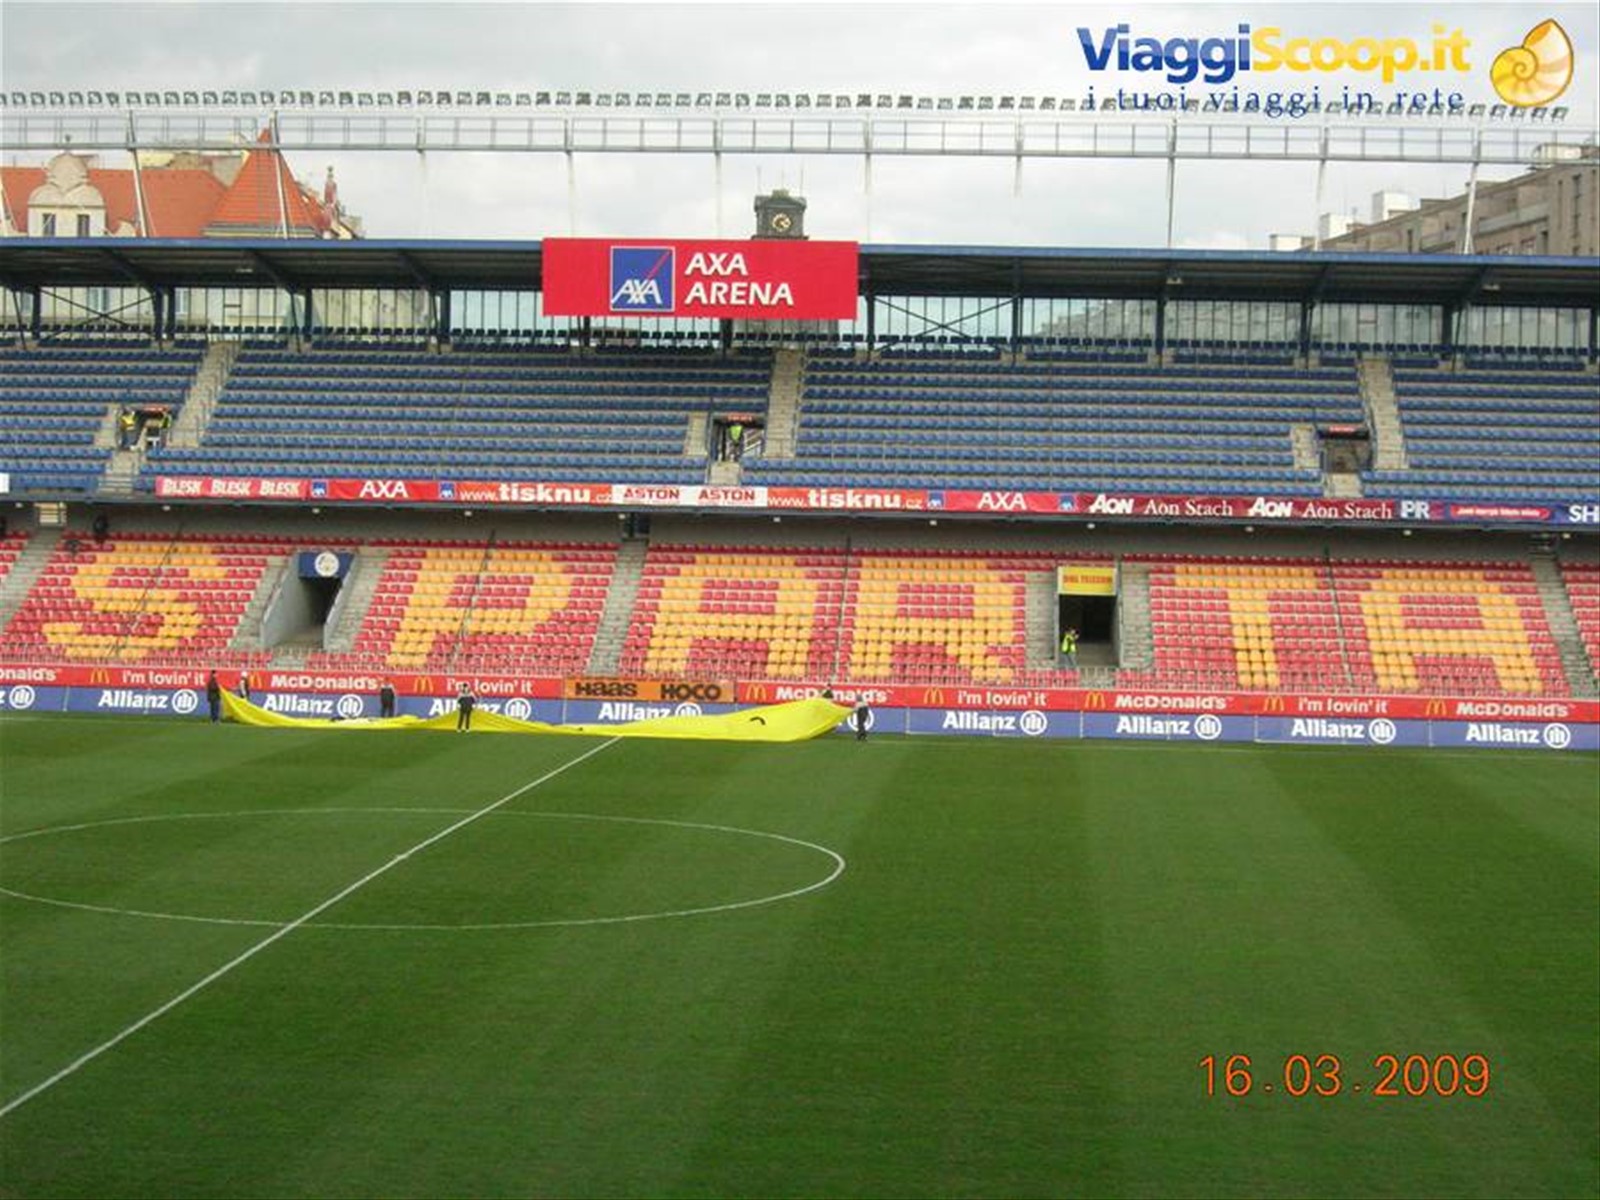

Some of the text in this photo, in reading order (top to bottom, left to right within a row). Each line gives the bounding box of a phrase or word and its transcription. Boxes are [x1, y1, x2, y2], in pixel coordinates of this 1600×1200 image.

[684, 252, 748, 276] AXA
[611, 279, 662, 305] AXA
[684, 281, 794, 306] ARENA
[162, 477, 202, 496] BLESK
[211, 478, 250, 497] BLESK
[259, 479, 300, 498] BLESK
[359, 480, 408, 498] AXA
[623, 487, 755, 501] ASTON ASTON
[767, 490, 924, 510] www.tisknu.cz
[977, 491, 1027, 511] AXA
[1143, 499, 1180, 516] Aon
[1185, 499, 1233, 517] Stach
[1301, 502, 1338, 519] Aon
[1344, 502, 1392, 520] Stach
[122, 671, 147, 684] i'm
[150, 671, 192, 685] lovin'
[271, 673, 378, 690] McDonald's
[519, 680, 532, 694] it
[99, 690, 167, 709] Allianz
[661, 683, 721, 700] HOCO
[957, 690, 1046, 706] i'm lovin' it
[263, 694, 333, 714] Allianz
[1115, 694, 1227, 710] McDonald's
[1298, 698, 1387, 713] i'm lovin' it
[1456, 702, 1568, 717] McDonald's
[943, 711, 1016, 730] Allianz
[1116, 716, 1190, 735] Allianz
[1291, 718, 1365, 739] Allianz
[1465, 722, 1540, 743] Allianz
